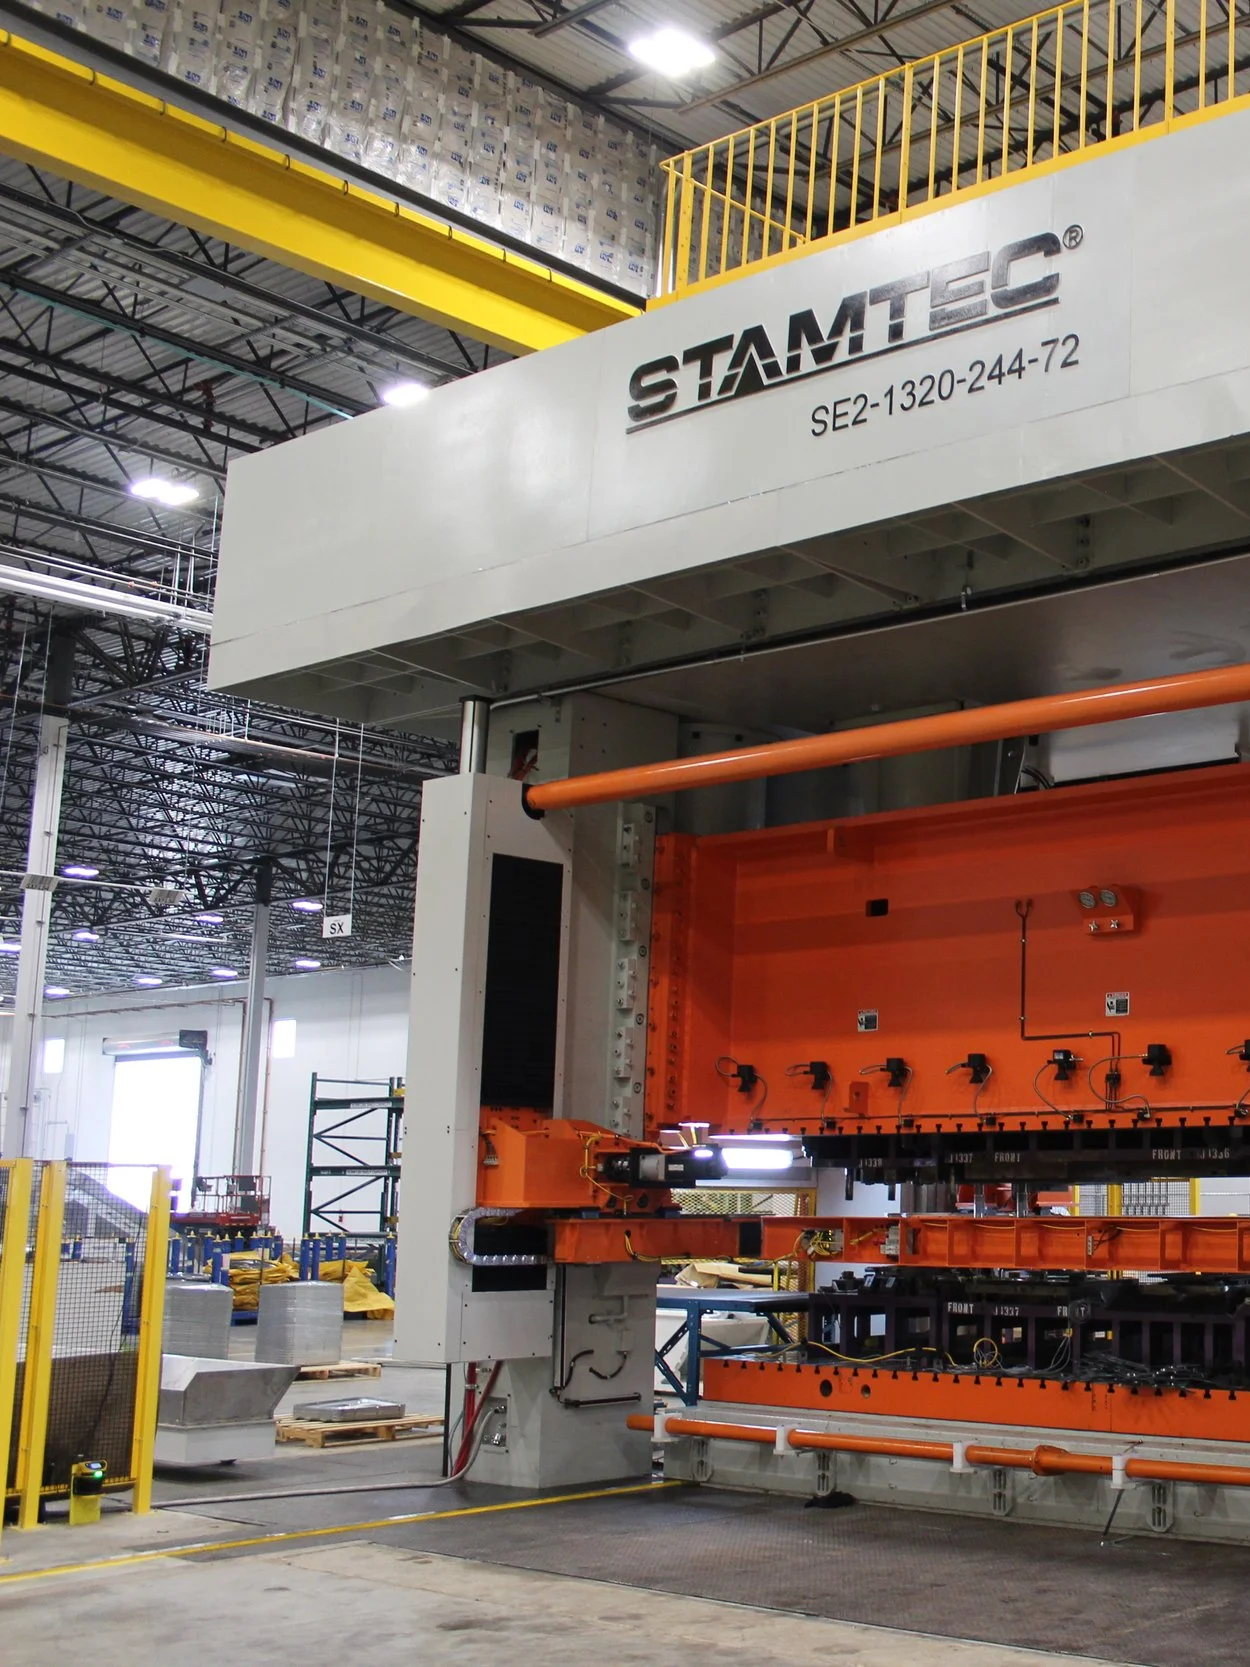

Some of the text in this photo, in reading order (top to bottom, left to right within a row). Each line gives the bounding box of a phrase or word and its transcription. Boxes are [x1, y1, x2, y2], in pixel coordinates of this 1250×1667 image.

[811, 334, 1080, 437] SE2-1320-244-72
[329, 922, 344, 935] SX
[994, 1152, 1021, 1163] FRONT
[1152, 1148, 1182, 1160] FRONT
[947, 1301, 974, 1315] FRONT
